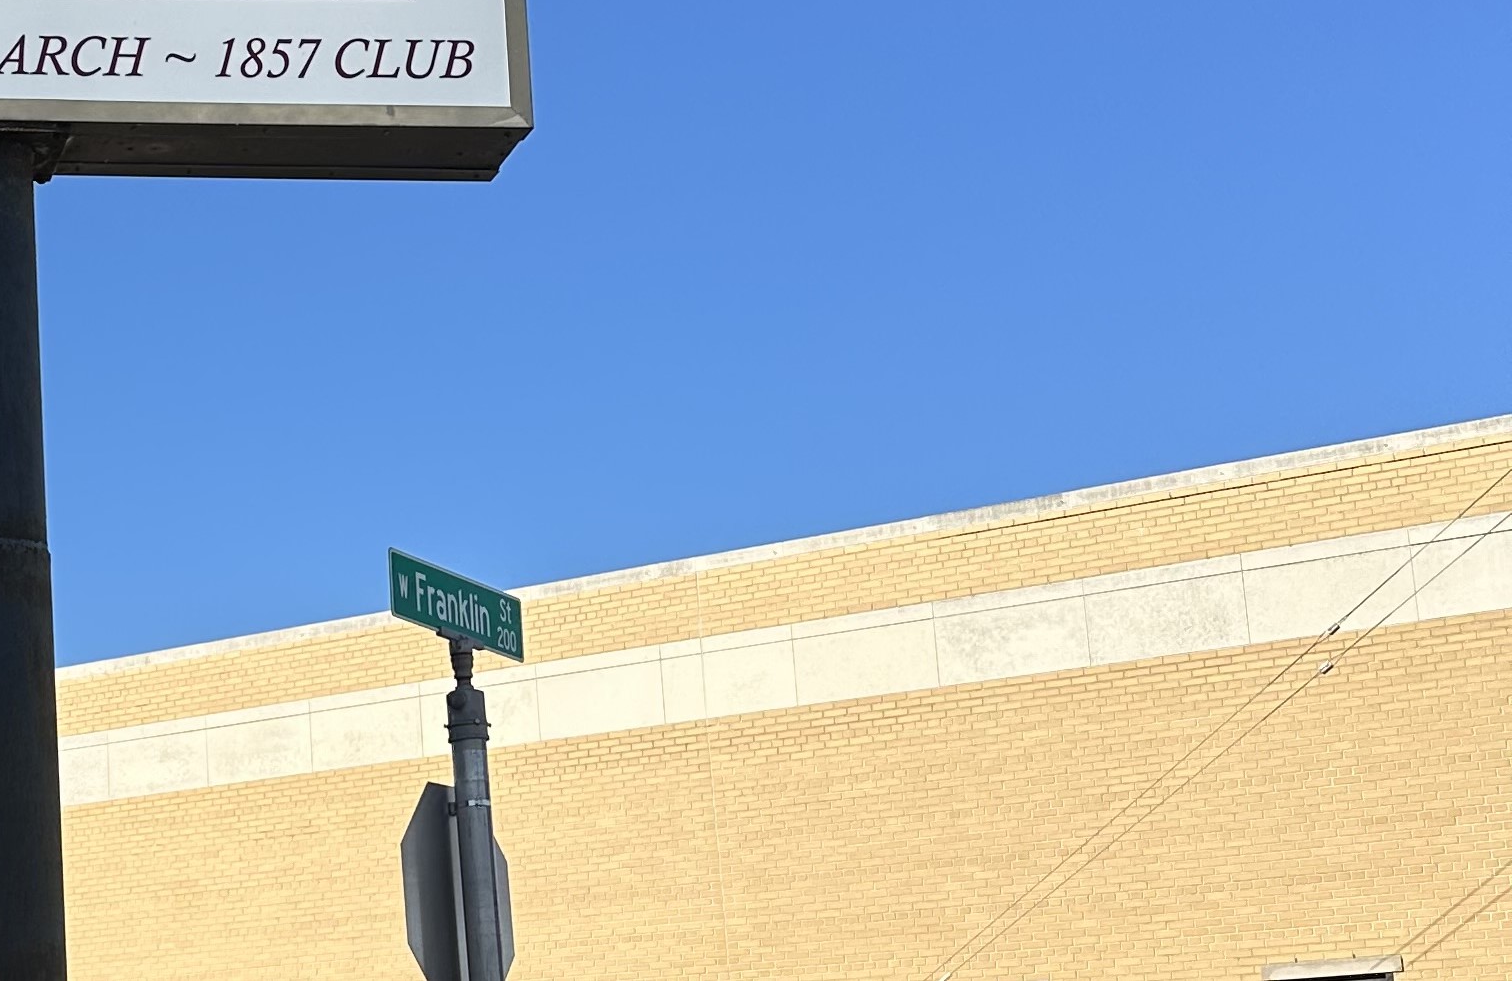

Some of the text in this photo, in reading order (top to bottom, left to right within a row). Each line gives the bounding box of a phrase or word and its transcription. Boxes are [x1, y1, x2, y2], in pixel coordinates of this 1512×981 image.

[215, 37, 322, 79] 1857
[334, 38, 475, 80] CLUB
[398, 571, 512, 638] W Franklin St
[497, 626, 517, 653] 200
